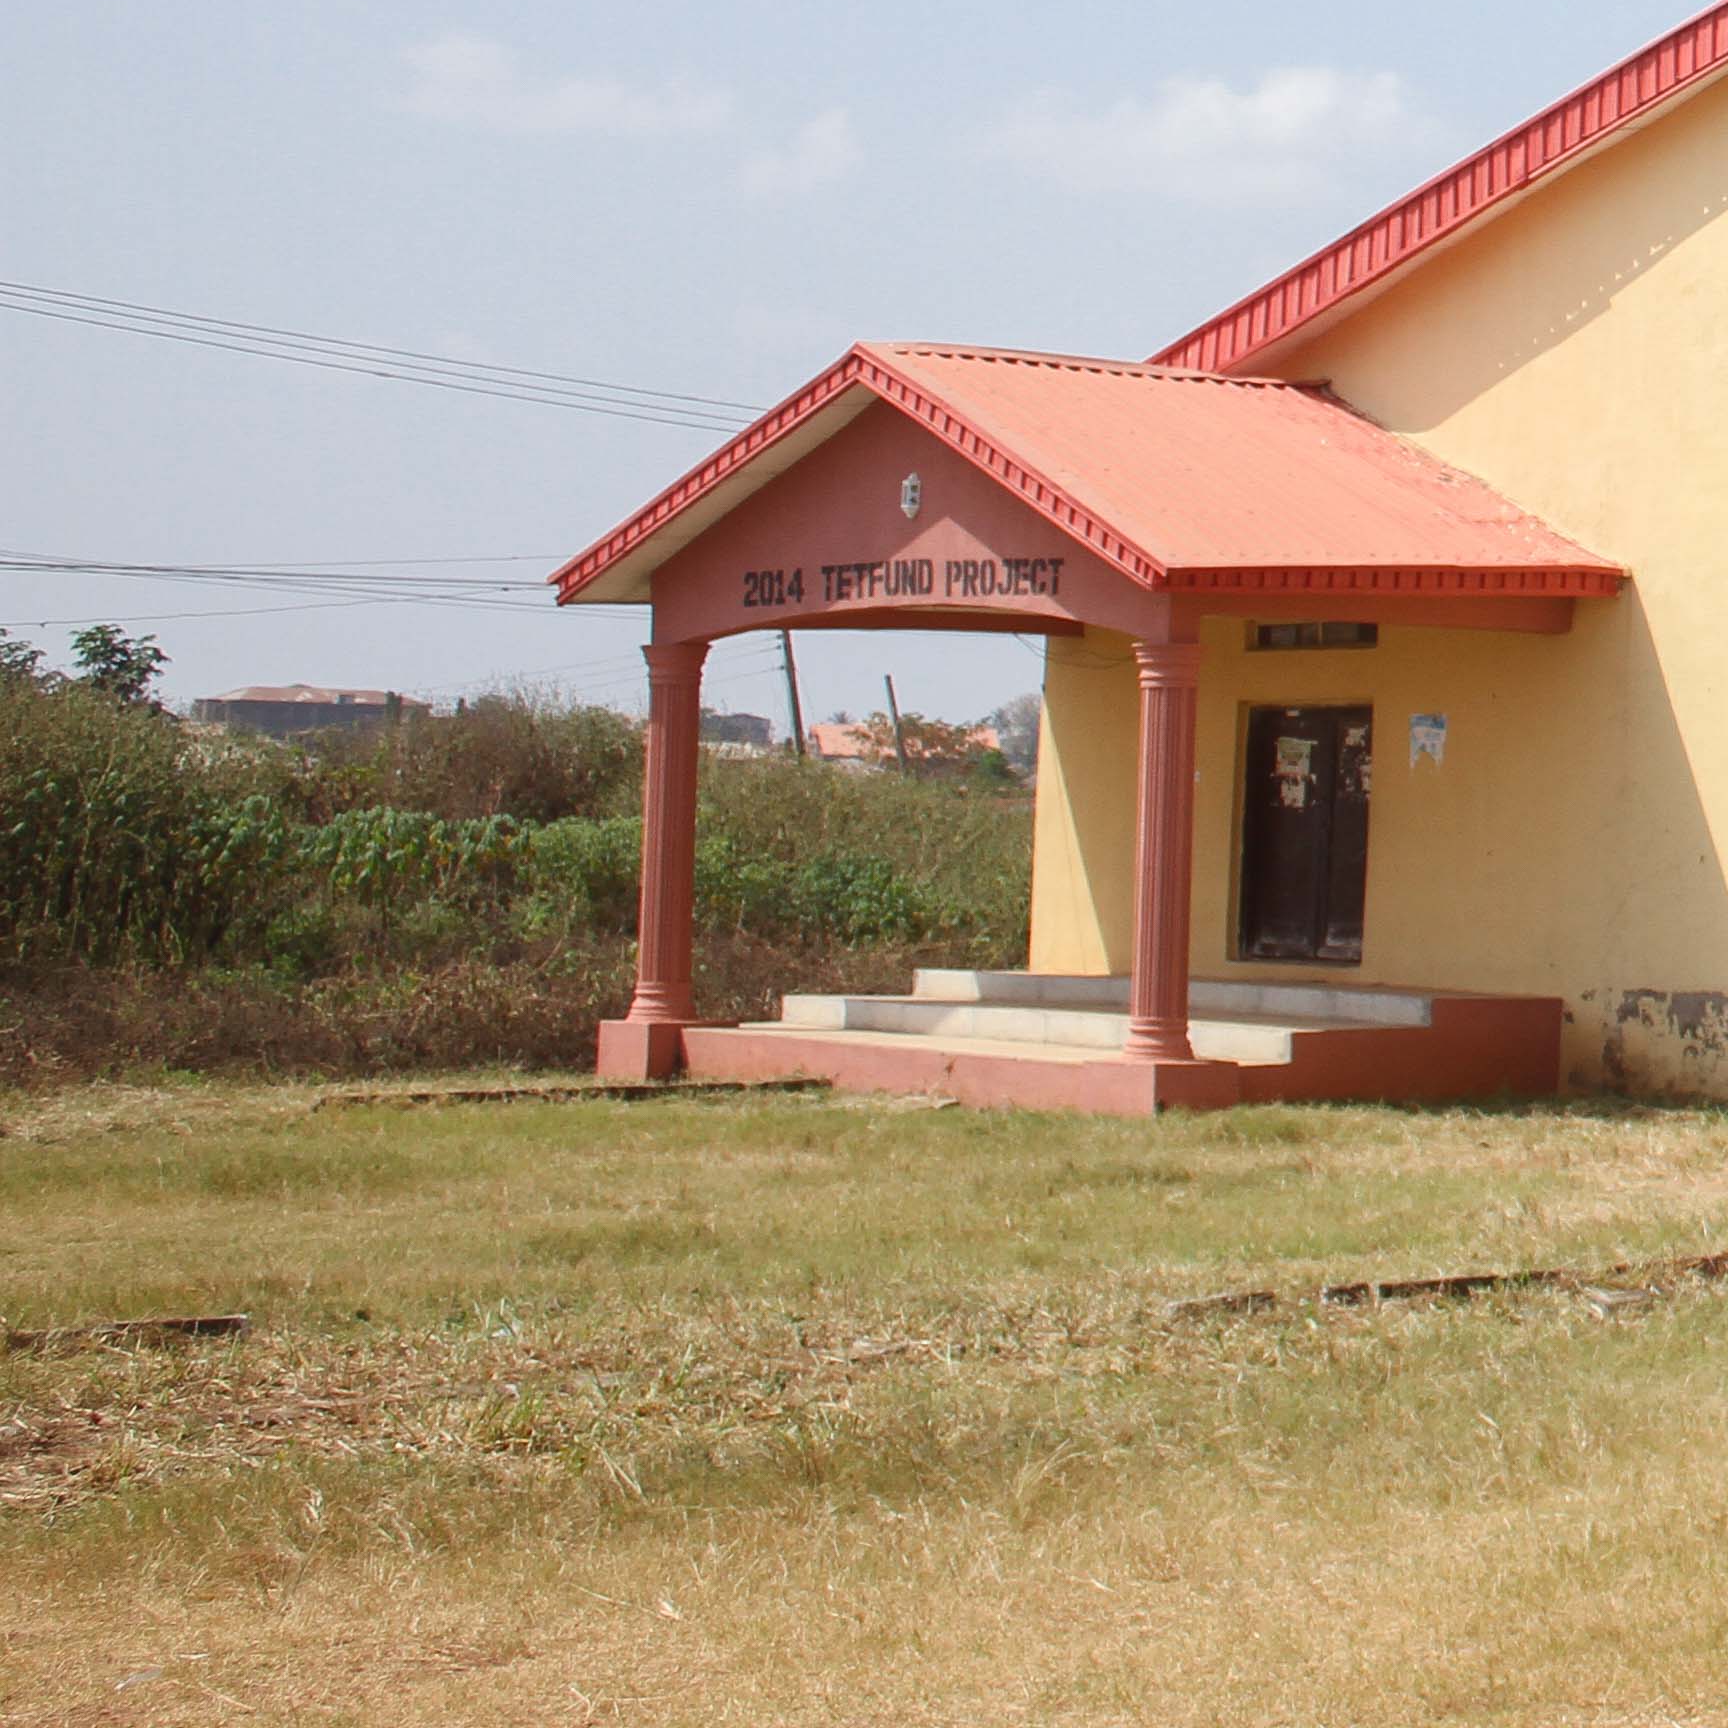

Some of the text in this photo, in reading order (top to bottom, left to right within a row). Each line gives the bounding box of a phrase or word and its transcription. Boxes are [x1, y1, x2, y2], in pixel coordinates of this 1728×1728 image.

[743, 558, 1064, 607] 2014 TETFUND PROJECT
